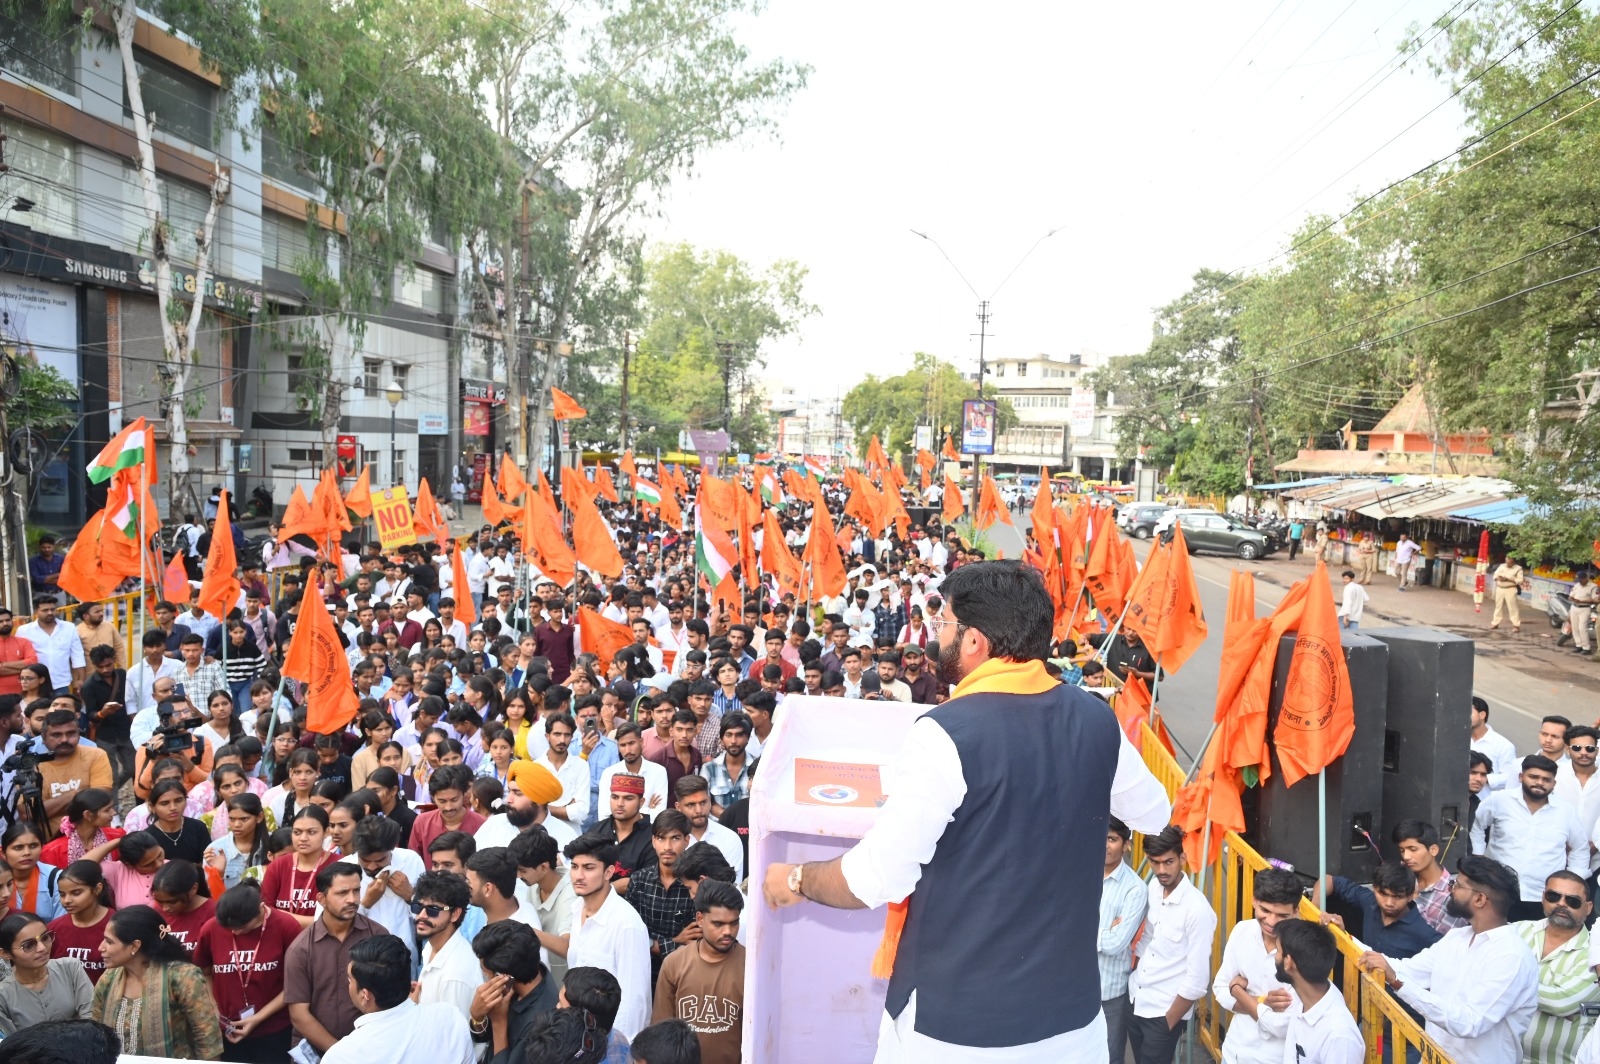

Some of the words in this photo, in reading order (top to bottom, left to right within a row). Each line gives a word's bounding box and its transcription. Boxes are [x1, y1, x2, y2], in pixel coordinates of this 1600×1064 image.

[65, 258, 127, 283] SAMSUNG
[377, 503, 409, 533] NO
[382, 527, 413, 543] PARKING
[292, 888, 312, 901] TIT
[66, 947, 92, 961] TIT
[228, 949, 255, 963] TIT
[213, 960, 279, 974] ECHNOCRATS
[678, 994, 740, 1026] GAP
